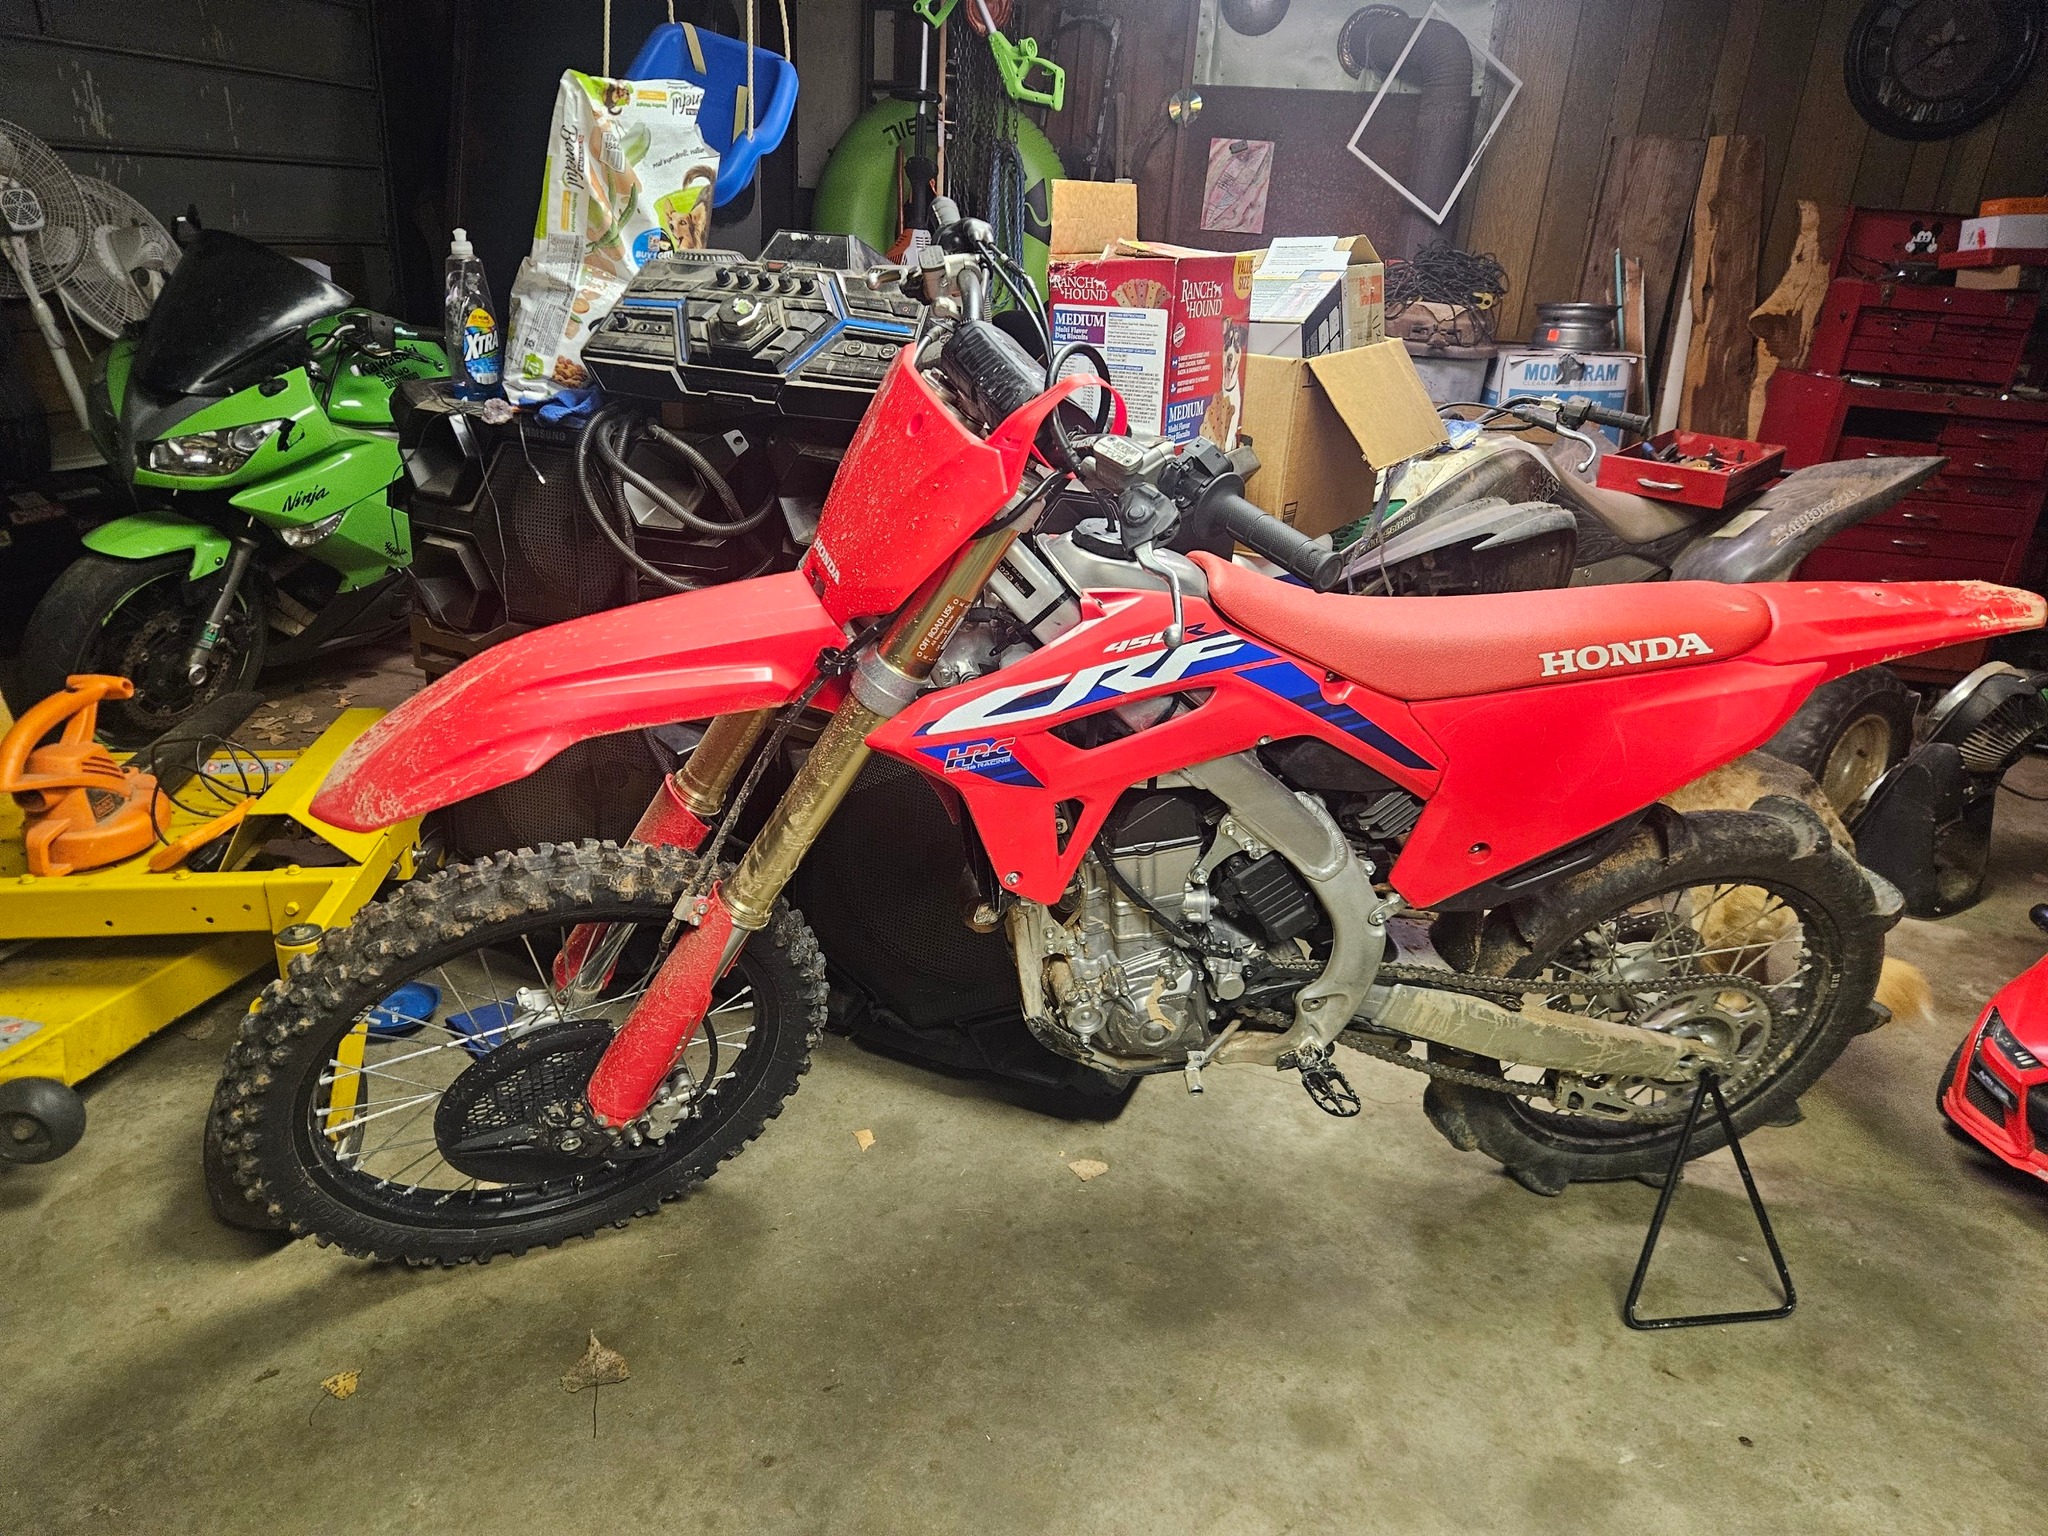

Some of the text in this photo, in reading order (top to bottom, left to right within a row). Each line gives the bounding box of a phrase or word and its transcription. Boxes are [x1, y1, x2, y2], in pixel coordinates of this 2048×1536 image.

[1052, 275, 1094, 292] RANCH
[1180, 279, 1215, 303] RANCH
[1238, 275, 1250, 290] SIZE
[1064, 288, 1108, 301] HOUND
[1188, 299, 1222, 319] HOUND
[1055, 312, 1104, 328] MEDIUM
[1055, 326, 1088, 335] Multi Flavor
[464, 330, 498, 361] XTRA
[1067, 333, 1088, 341] Biscuits
[1524, 363, 1620, 382] MONRAM
[1169, 400, 1204, 422] MEDIUM
[281, 484, 330, 512] Ninja
[813, 536, 840, 585] HONDA
[918, 604, 955, 651] OFF ROAD USE
[1538, 632, 1714, 677] HONDA
[926, 633, 1246, 735] CRF
[944, 737, 1016, 769] HRC
[977, 757, 1011, 769] RACING
